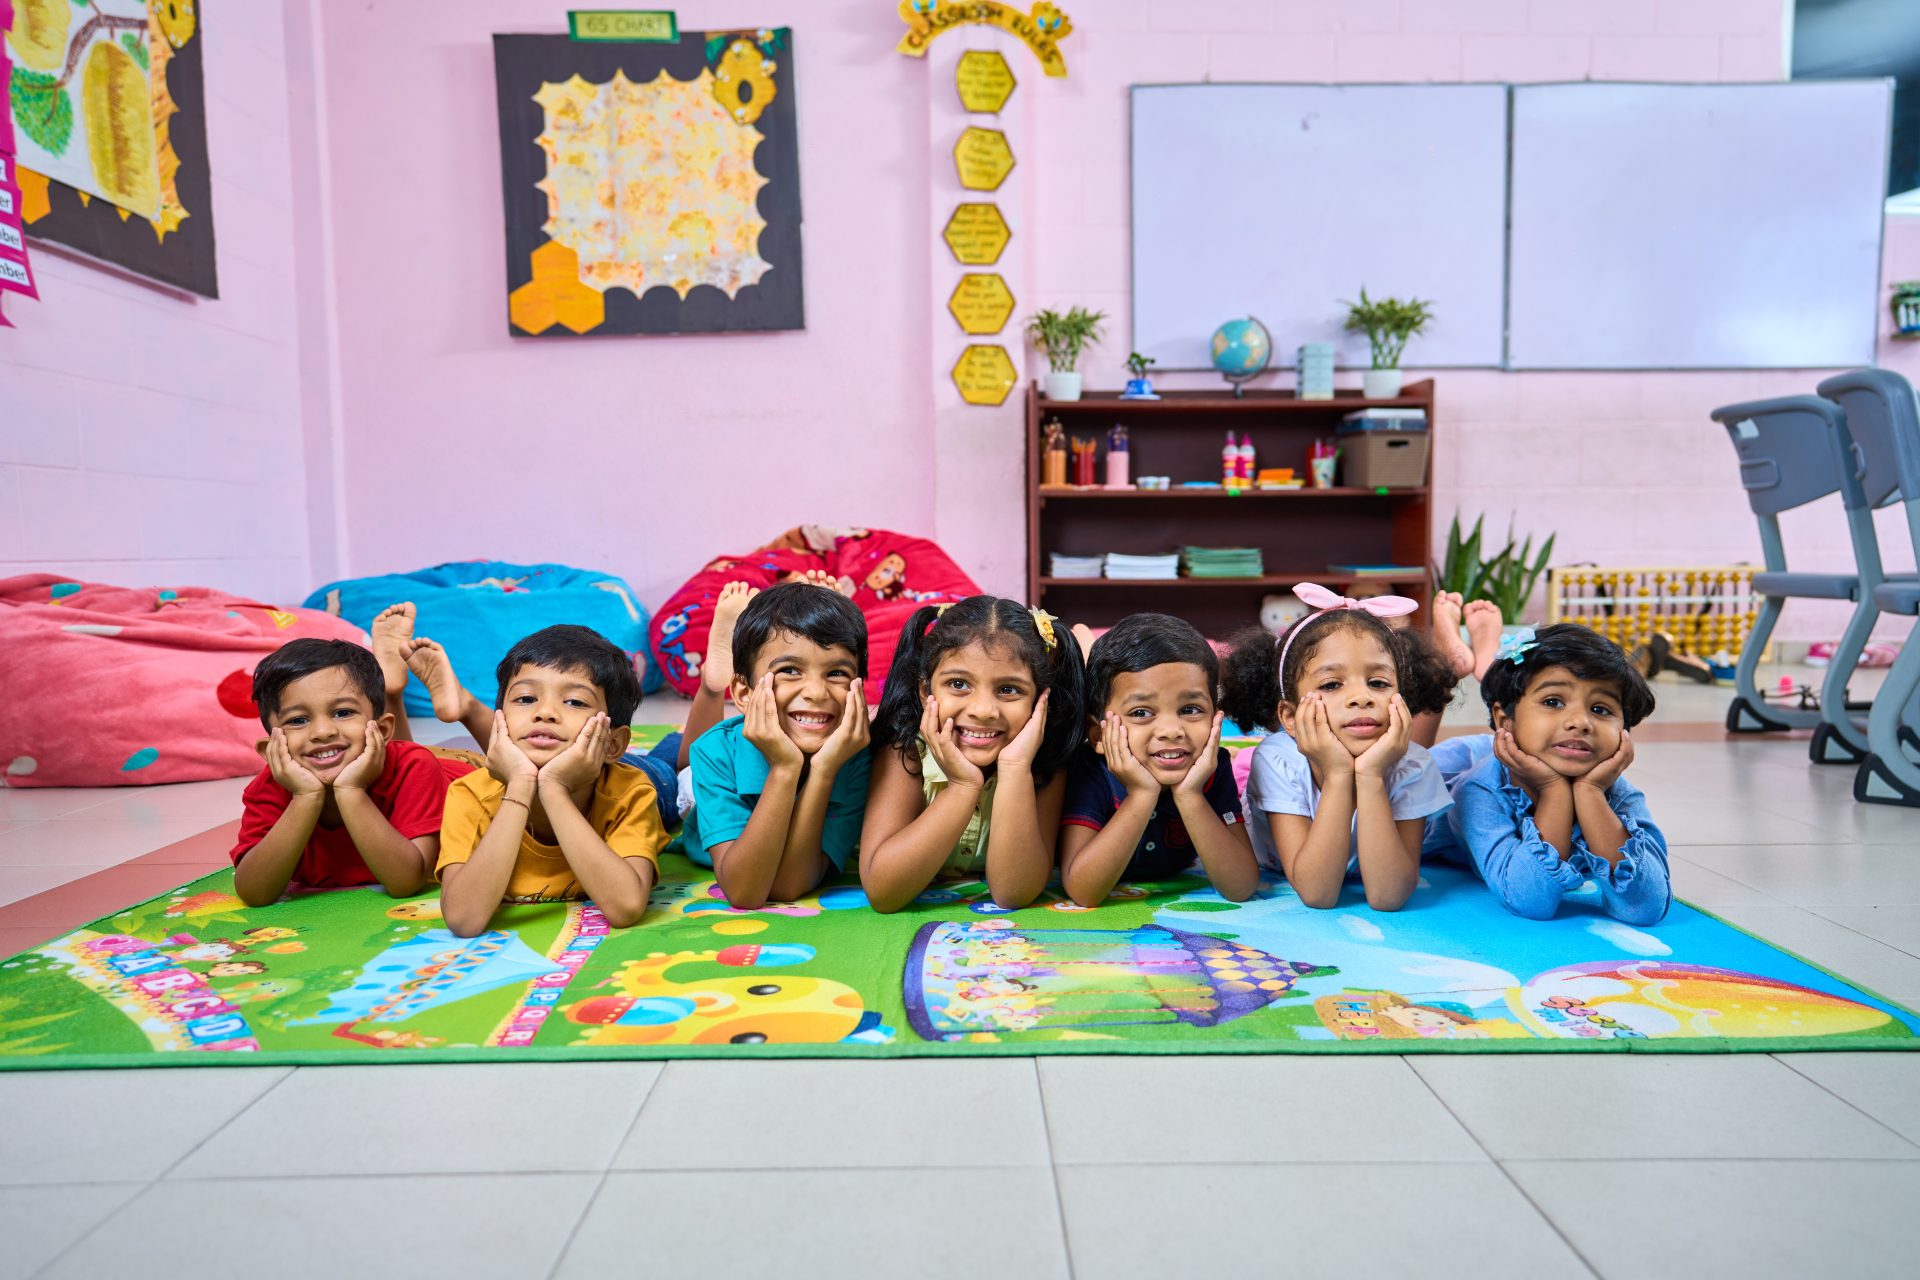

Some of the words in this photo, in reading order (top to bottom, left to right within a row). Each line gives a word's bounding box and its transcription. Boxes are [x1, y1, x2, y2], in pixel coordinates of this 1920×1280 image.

[114, 955, 171, 974] A
[558, 953, 589, 963] N
[140, 972, 197, 992] B
[170, 996, 223, 1013] C
[533, 990, 561, 1002] P
[190, 1016, 244, 1038] D
[503, 1029, 535, 1041] R
